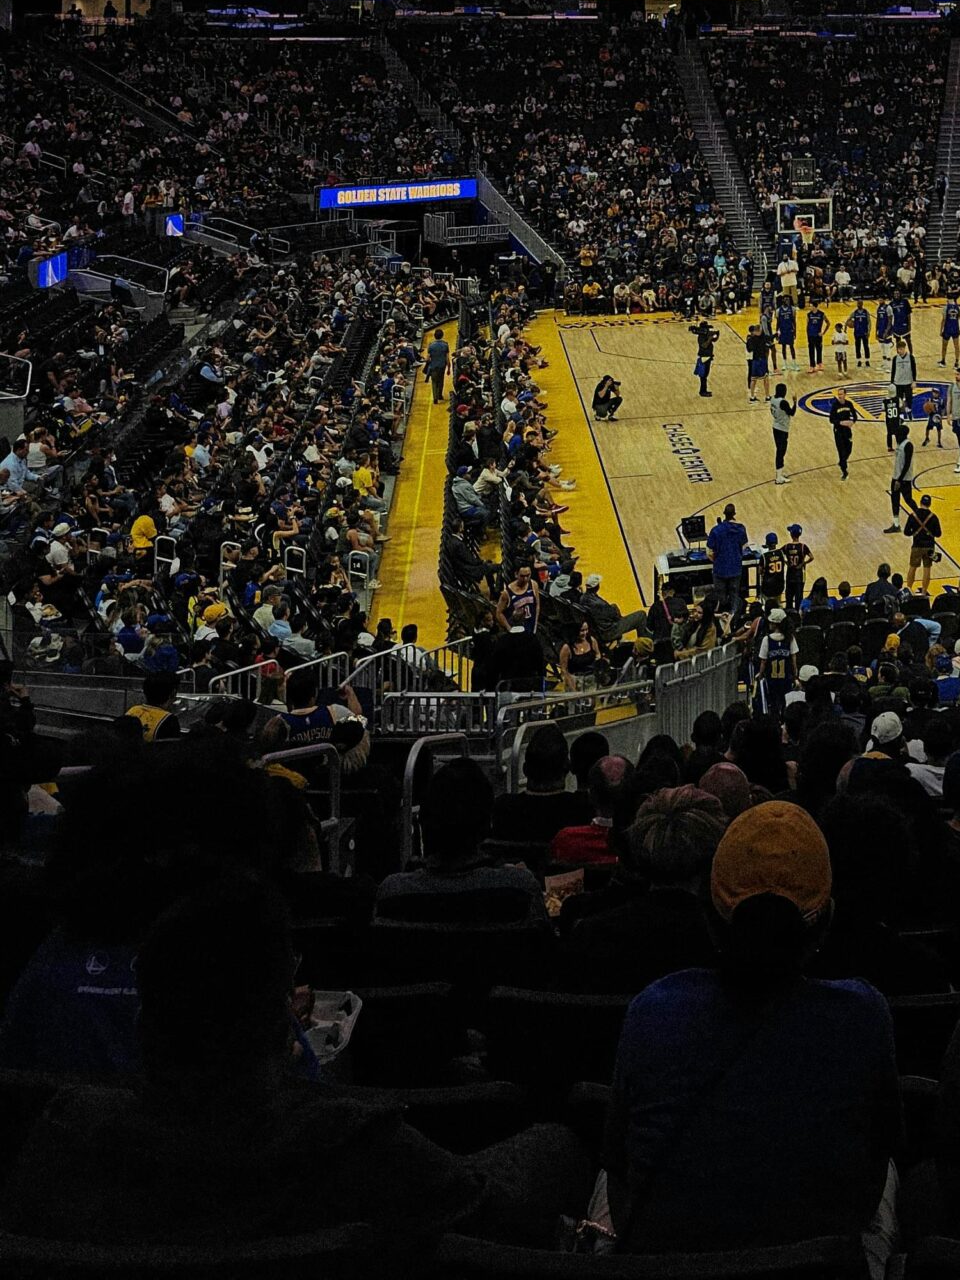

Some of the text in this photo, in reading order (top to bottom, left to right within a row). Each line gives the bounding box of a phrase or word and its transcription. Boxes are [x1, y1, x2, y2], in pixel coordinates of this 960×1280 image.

[336, 183, 461, 204] GOLDEN STATE WARRIORS
[662, 423, 714, 484] CHASE CENTER
[768, 560, 783, 574] 30
[770, 658, 786, 680] 11
[290, 726, 333, 743] OMPSON
